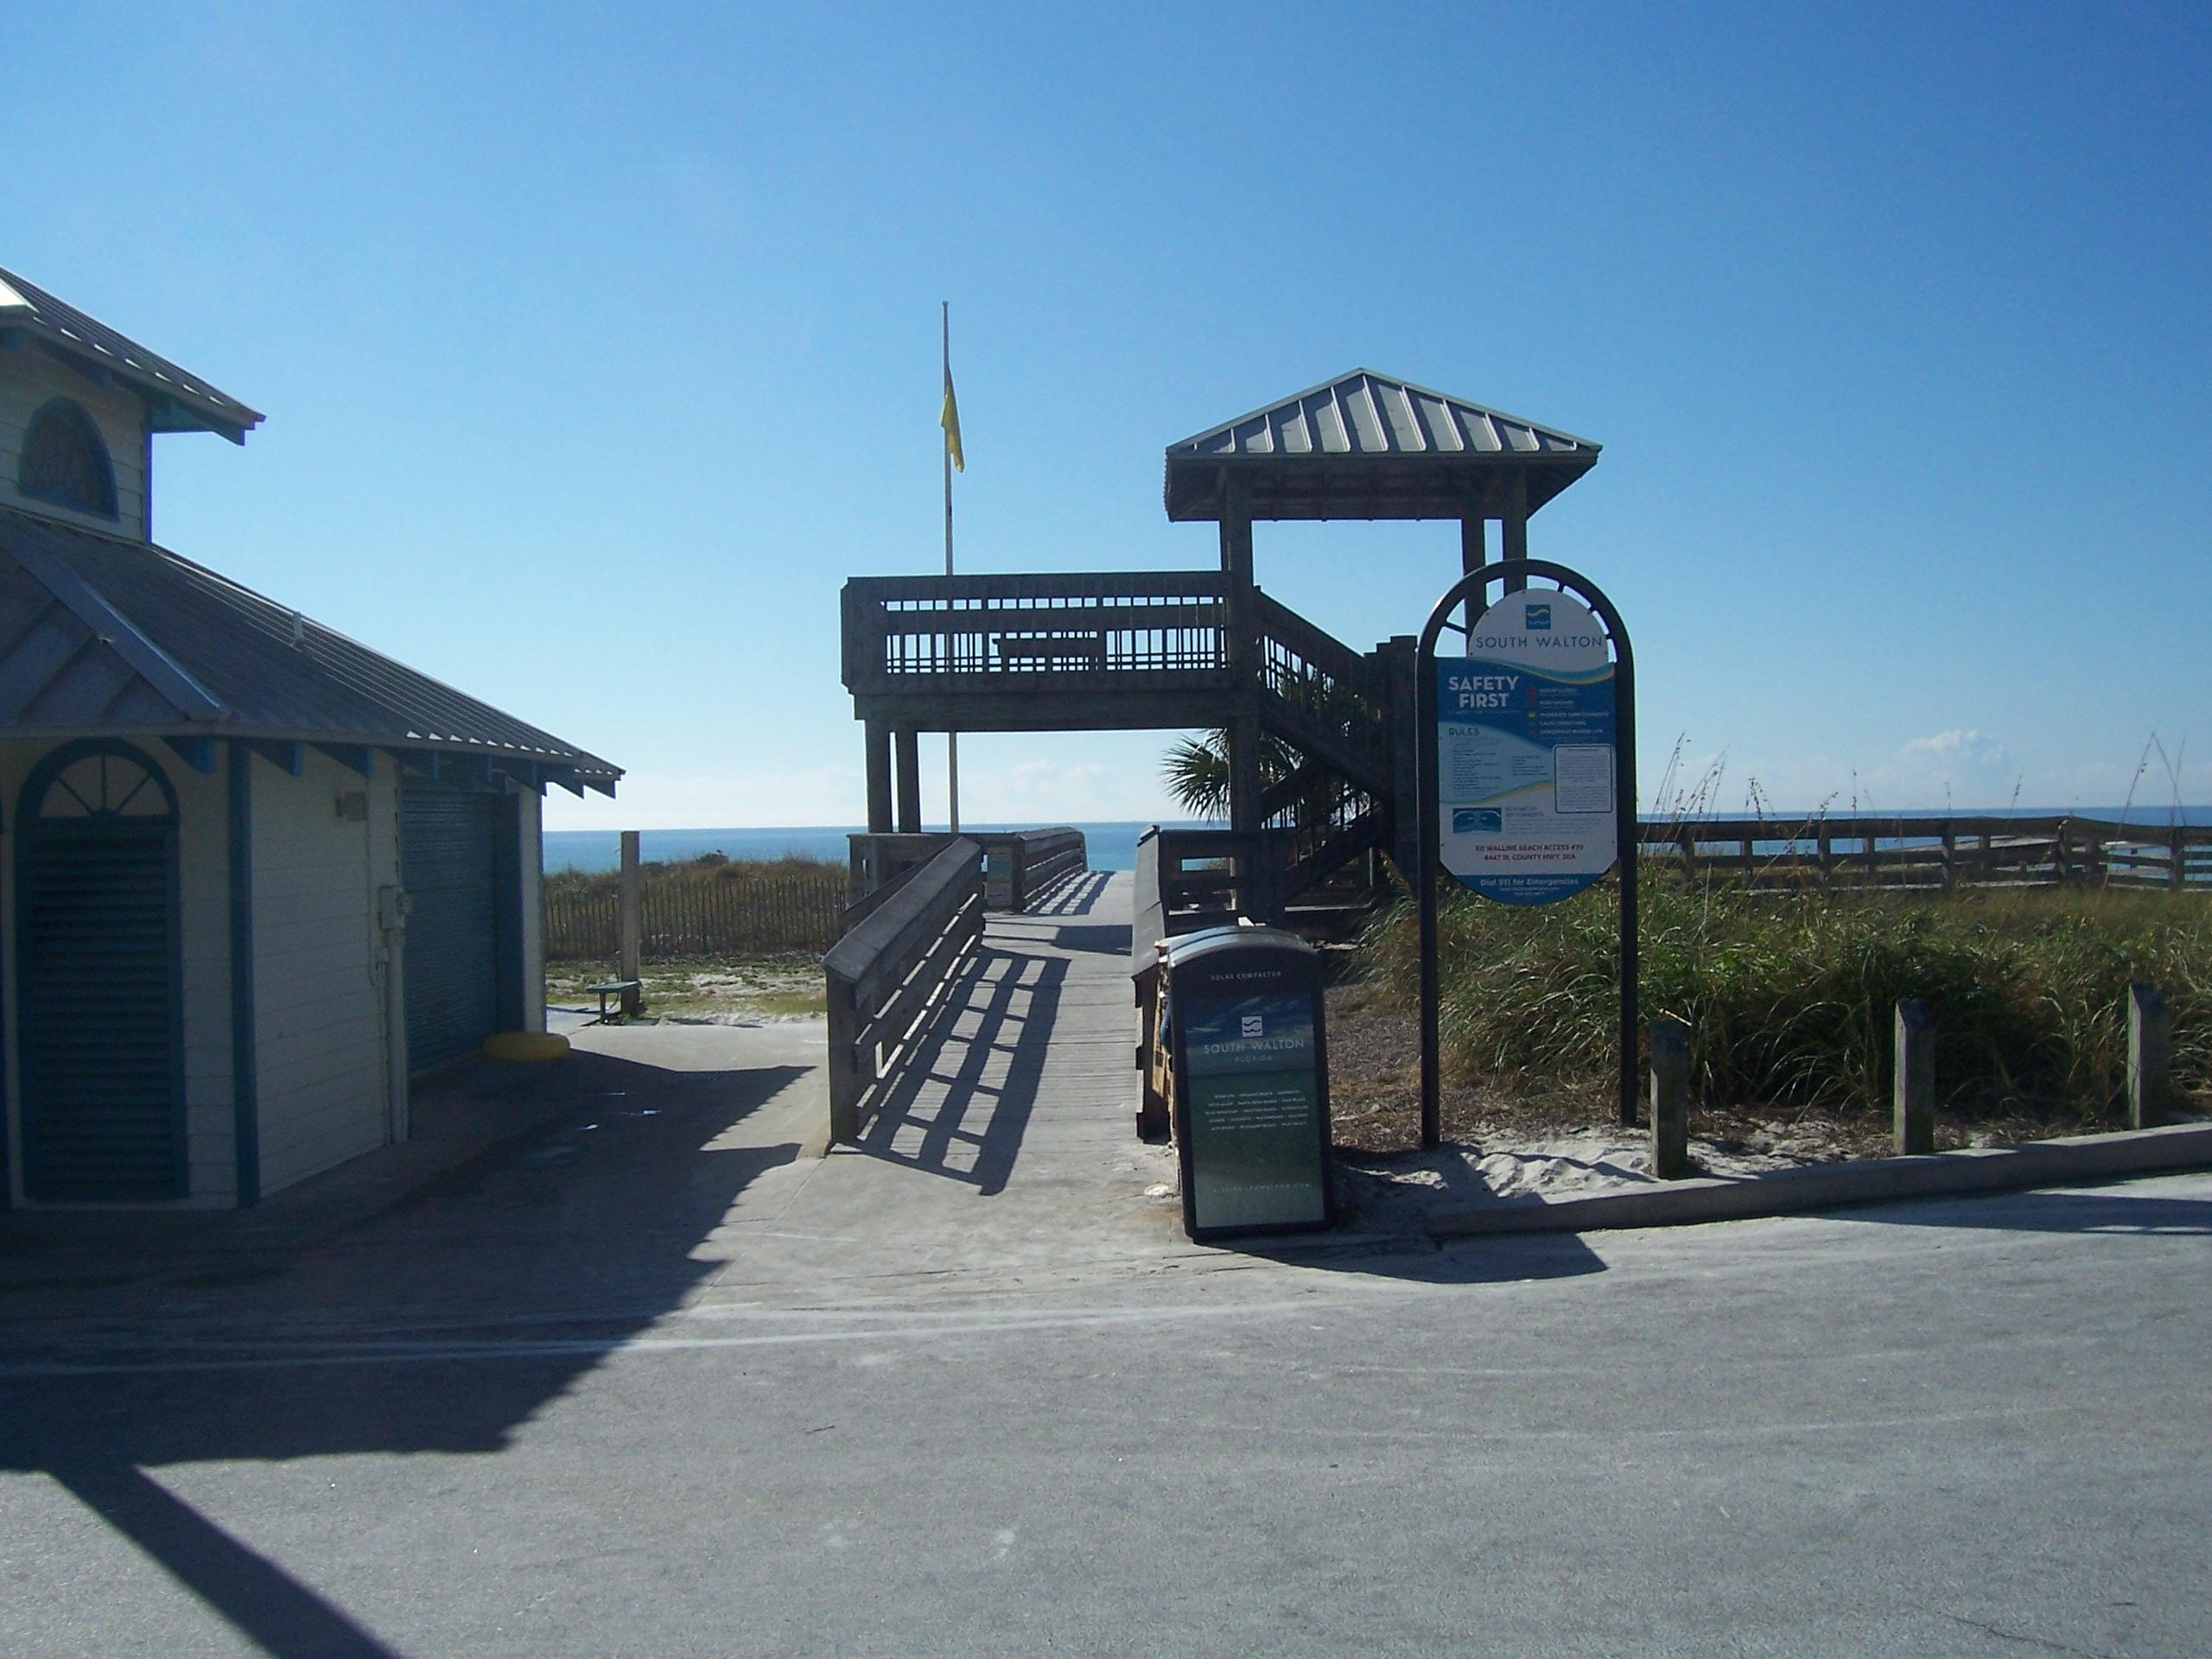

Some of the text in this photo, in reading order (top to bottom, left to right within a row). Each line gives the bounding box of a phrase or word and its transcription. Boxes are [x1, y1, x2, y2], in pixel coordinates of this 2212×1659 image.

[1476, 635, 1603, 648] SOUTH WALTON
[1448, 676, 1520, 691] SAFETY
[1459, 693, 1510, 709] FIRST
[1448, 727, 1479, 736] RULES
[1237, 971, 1281, 980] COMPACTOR
[1204, 1039, 1305, 1054] SOUTH WALTON
